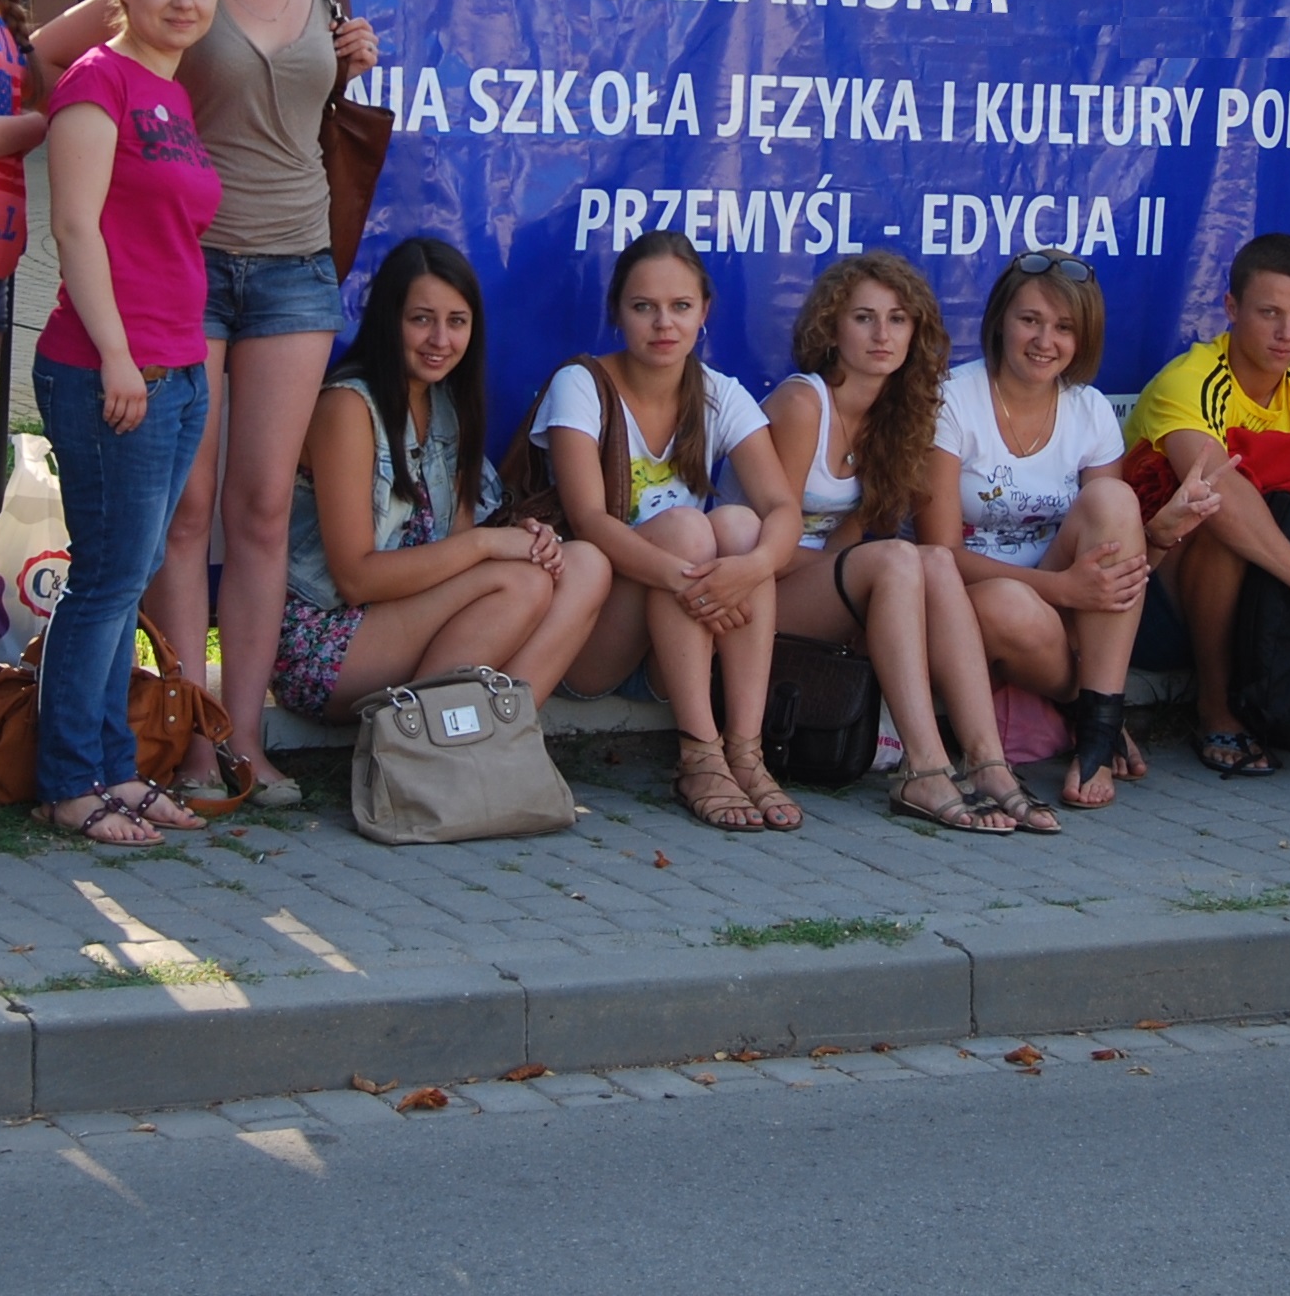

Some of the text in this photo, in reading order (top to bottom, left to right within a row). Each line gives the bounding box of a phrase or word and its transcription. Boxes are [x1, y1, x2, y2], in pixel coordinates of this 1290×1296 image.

[717, 74, 922, 155] JĘZYKA
[941, 81, 955, 142] I
[975, 82, 1204, 147] KULTURY
[575, 174, 864, 255] PRZEMYŚL
[921, 194, 1120, 256] EDYCJA
[1136, 197, 1165, 255] II
[987, 465, 1018, 488] All
